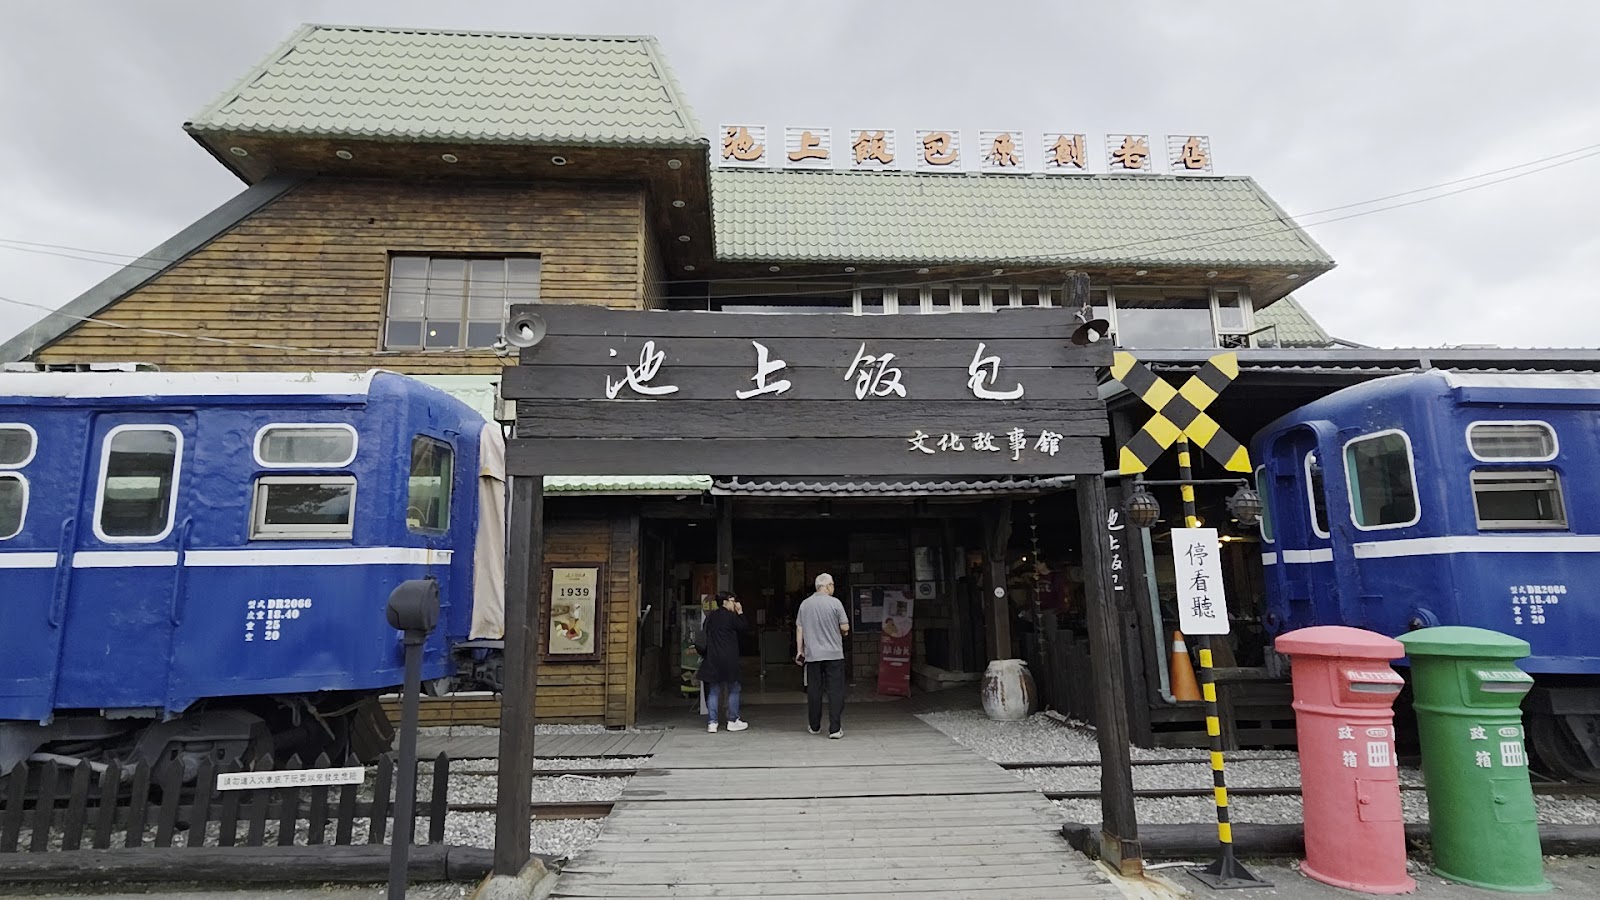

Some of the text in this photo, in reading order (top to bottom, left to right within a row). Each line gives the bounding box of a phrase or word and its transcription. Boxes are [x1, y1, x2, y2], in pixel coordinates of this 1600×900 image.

[721, 126, 1210, 170] 池上飯包原創老店
[605, 340, 1024, 399] 池上飯包
[907, 427, 1064, 461] 文化故事館
[1185, 542, 1216, 618] 停看聽
[560, 588, 590, 597] 1939
[1529, 595, 1558, 604] 18.40
[267, 609, 300, 619] 18.40
[1530, 605, 1544, 614] 25
[265, 620, 280, 630] 25
[1531, 615, 1546, 624] 20
[264, 631, 280, 641] 20
[1338, 726, 1355, 740] 政
[1469, 725, 1488, 740] 政
[1343, 750, 1358, 768] 箱
[1475, 750, 1492, 768] 箱
